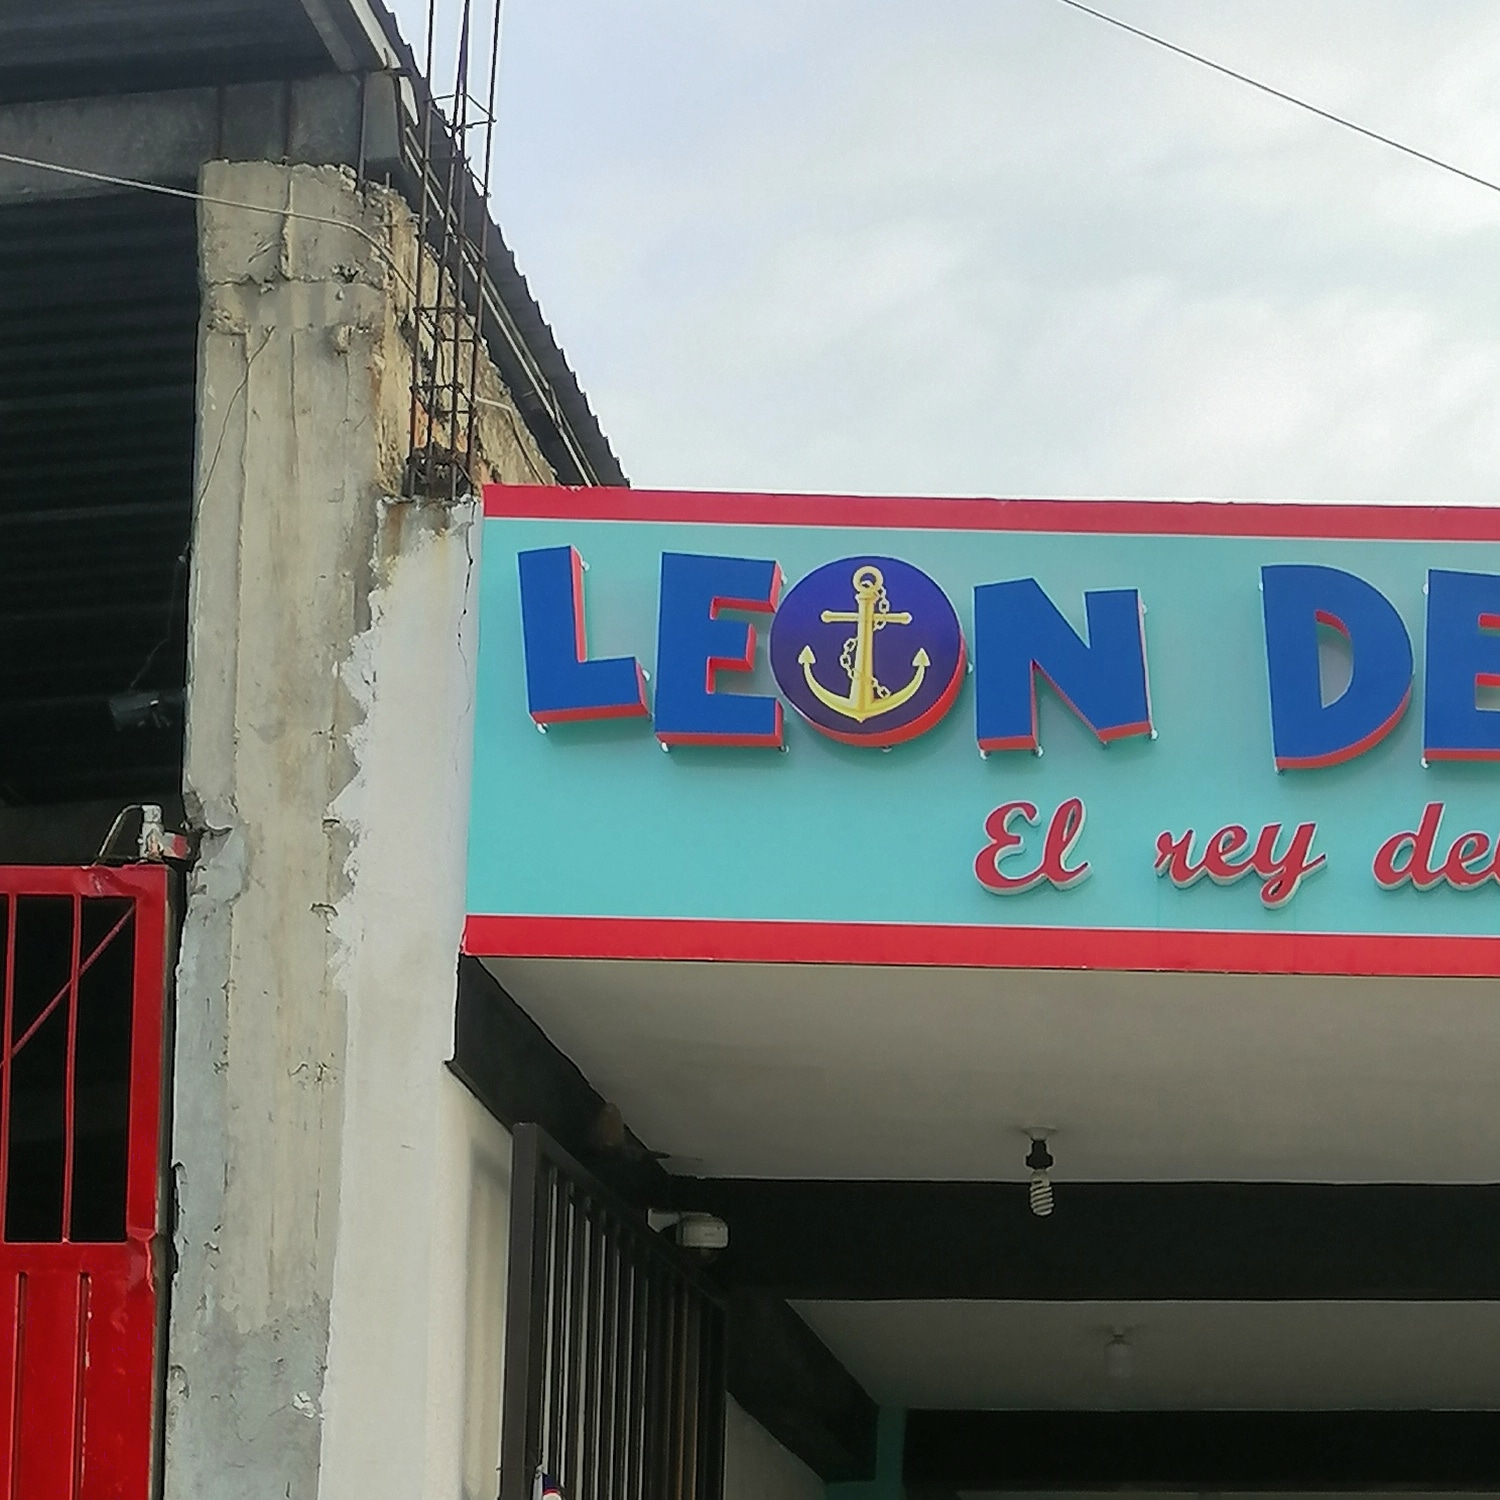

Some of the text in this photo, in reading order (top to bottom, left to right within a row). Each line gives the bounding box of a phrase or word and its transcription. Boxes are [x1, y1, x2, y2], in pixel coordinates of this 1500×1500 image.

[517, 545, 1153, 751] LEON
[973, 798, 1093, 895] El
[1154, 821, 1326, 909] rey
